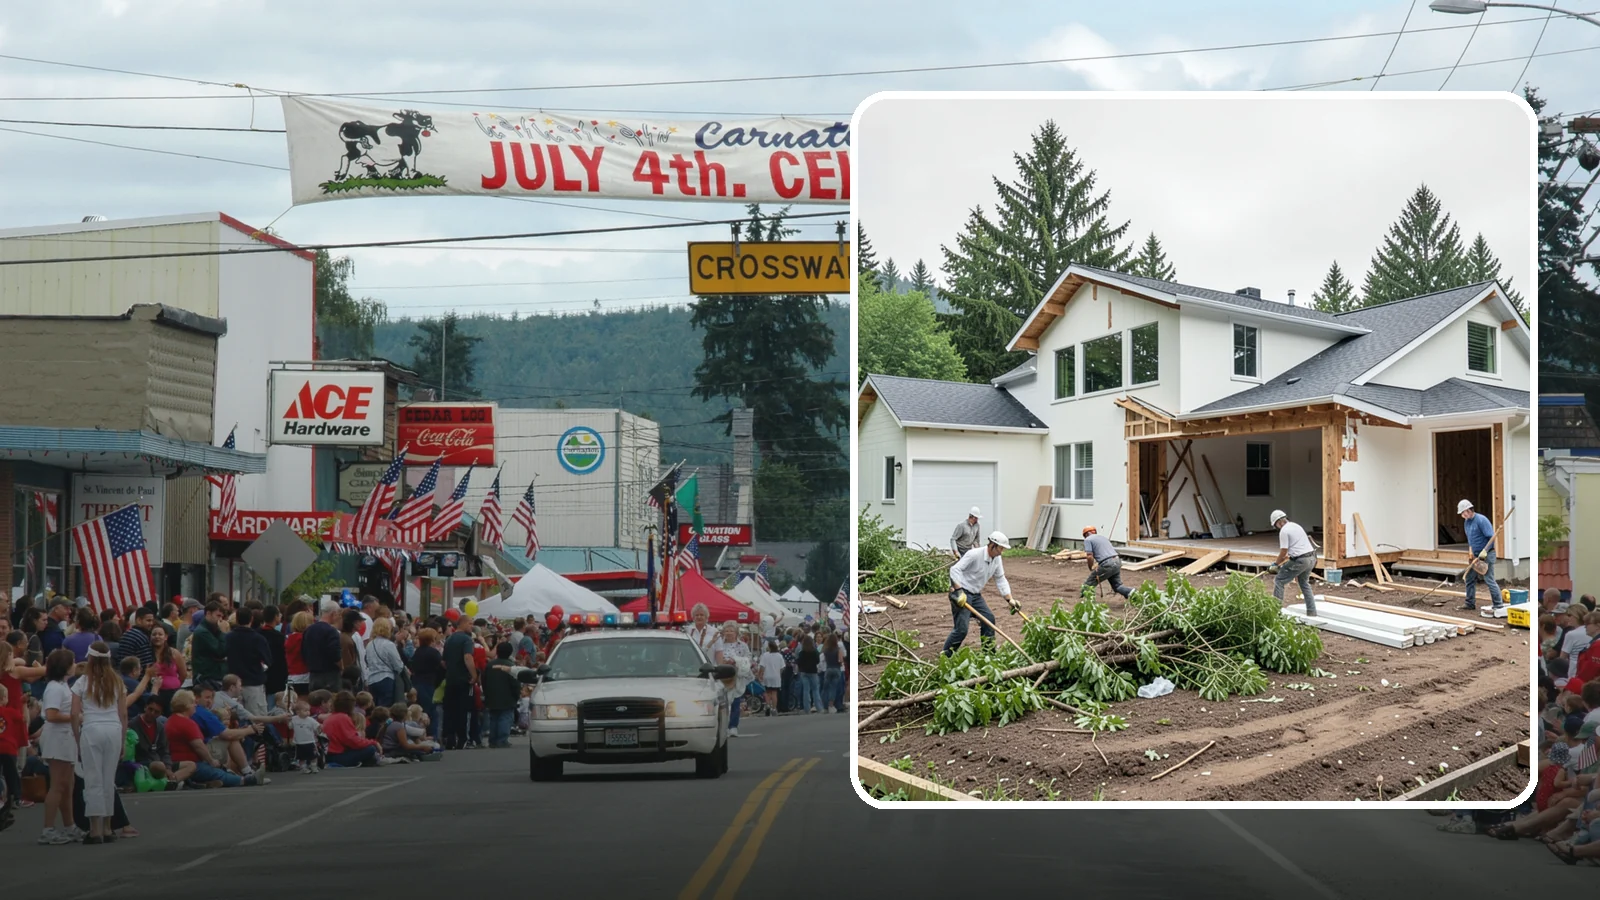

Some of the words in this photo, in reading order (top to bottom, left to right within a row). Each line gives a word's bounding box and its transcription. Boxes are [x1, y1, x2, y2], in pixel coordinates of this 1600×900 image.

[695, 121, 850, 149] Carnat
[481, 141, 604, 192] JULY
[632, 150, 746, 197] 4th.
[697, 254, 850, 279] CROSSWA
[282, 380, 373, 420] ACE
[405, 409, 452, 422] CEDAR
[283, 421, 371, 436] Hardware
[353, 467, 384, 480] Simpl
[83, 486, 94, 495] St.
[96, 485, 124, 495] Vincent
[126, 486, 136, 495] de
[137, 486, 155, 495] Paul
[688, 526, 741, 535] CRNATION
[699, 535, 730, 543] GLASS
